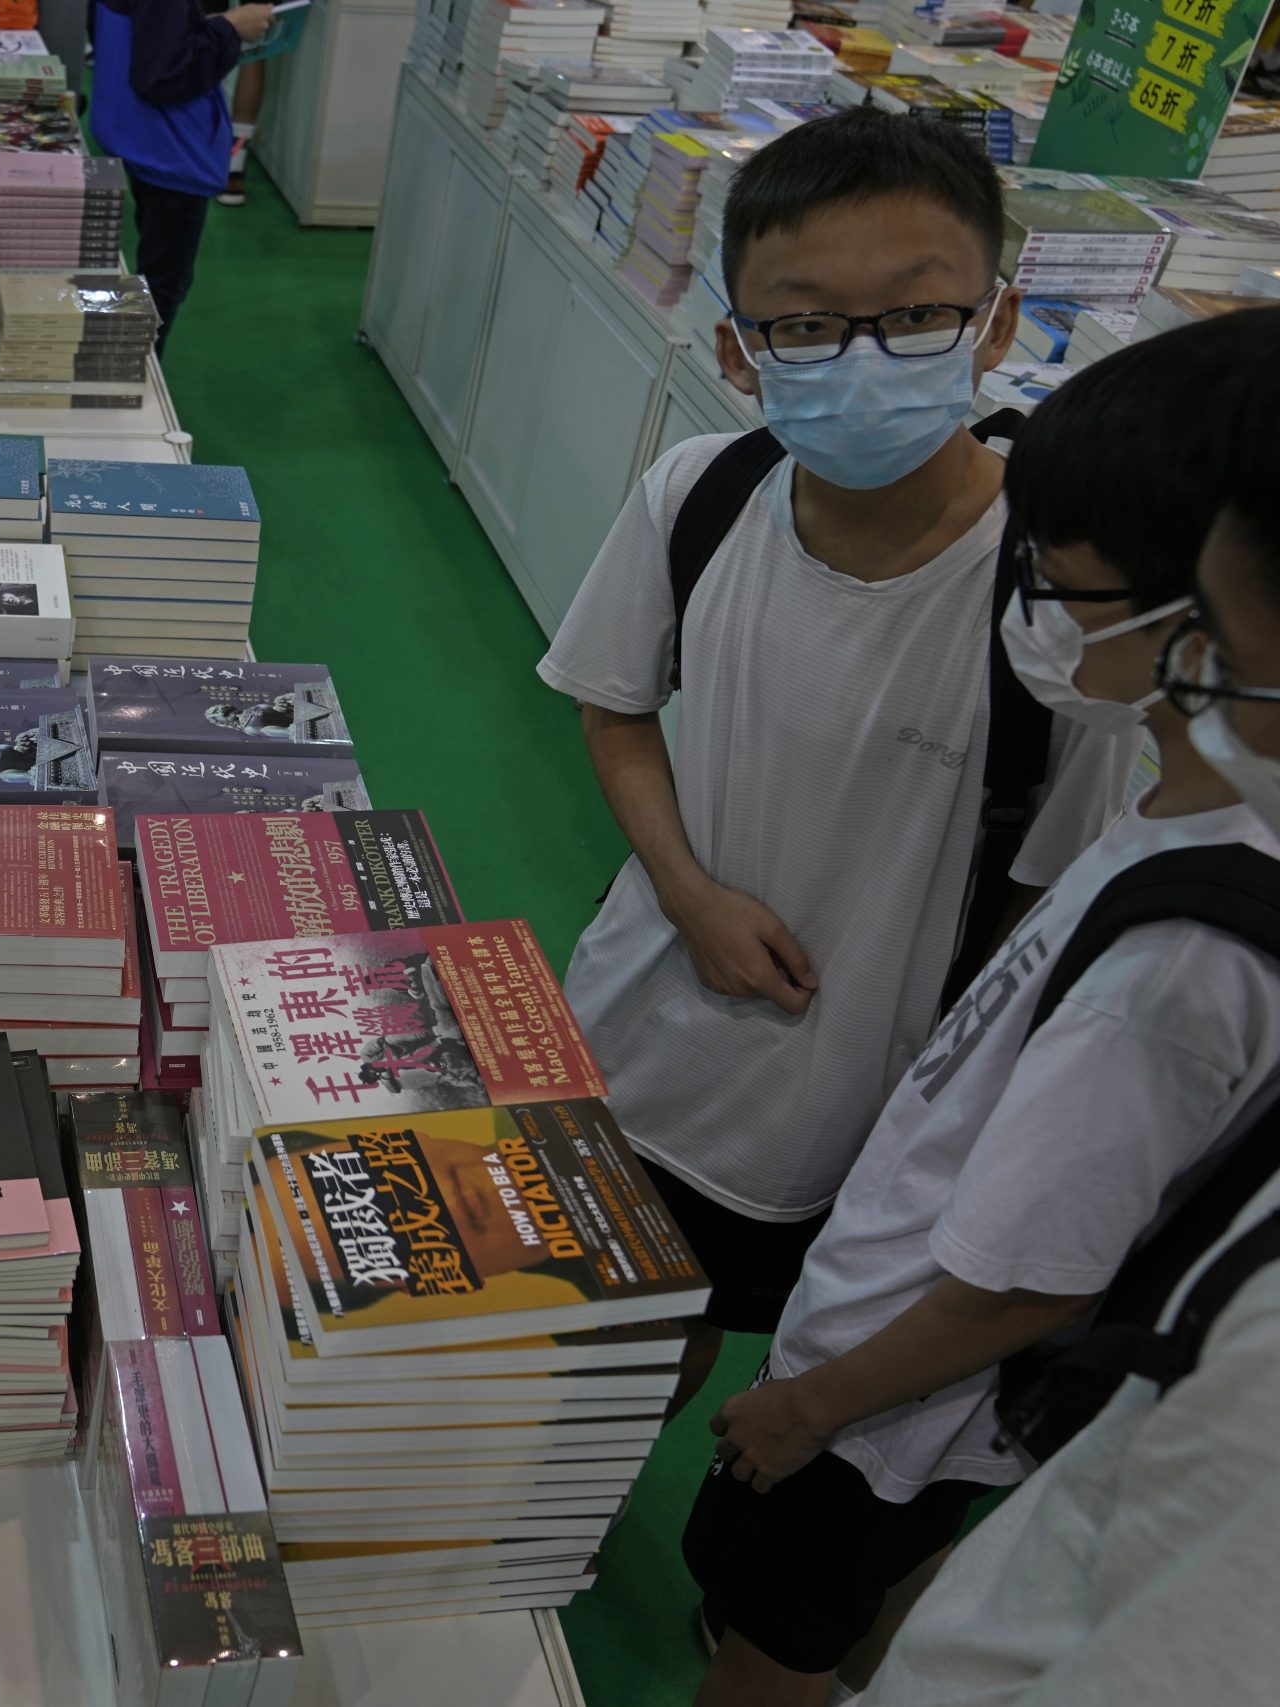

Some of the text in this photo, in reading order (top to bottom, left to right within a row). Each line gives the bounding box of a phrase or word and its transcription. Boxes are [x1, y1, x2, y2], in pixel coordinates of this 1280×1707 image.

[1110, 7, 1140, 34] 3-5本
[1086, 49, 1132, 87] 6本或以上
[103, 664, 246, 680] 中國近代史
[117, 760, 271, 779] 中國近代史
[36, 810, 106, 822] 最佳歷史選
[354, 819, 392, 885] DIKÖTTER
[148, 817, 190, 945] THE TRAGEDY
[172, 817, 217, 946] OF LIBERATION
[262, 815, 334, 939] 解放的悲劇
[322, 839, 360, 912] 1945 1957
[241, 992, 280, 1071] 中國浩劫史
[261, 1008, 286, 1054] 1958-1962
[264, 946, 379, 1104] 毛澤東的
[466, 935, 547, 1086] 馮客經典作品全新中文譯本
[491, 934, 570, 1083] Mao's Great Famine
[85, 1151, 181, 1172] 馮客三部曲
[491, 1165, 511, 1185] BE
[498, 1136, 584, 1259] DICTATOR
[499, 1187, 520, 1208] TO
[309, 1149, 410, 1287] 獨裁者
[364, 1129, 475, 1297] 養成之路
[509, 1207, 541, 1246] HOW
[143, 1240, 168, 1312] 文化大革命
[173, 1218, 206, 1296] 解放的悲劇
[150, 1533, 266, 1565] 馮客三部曲
